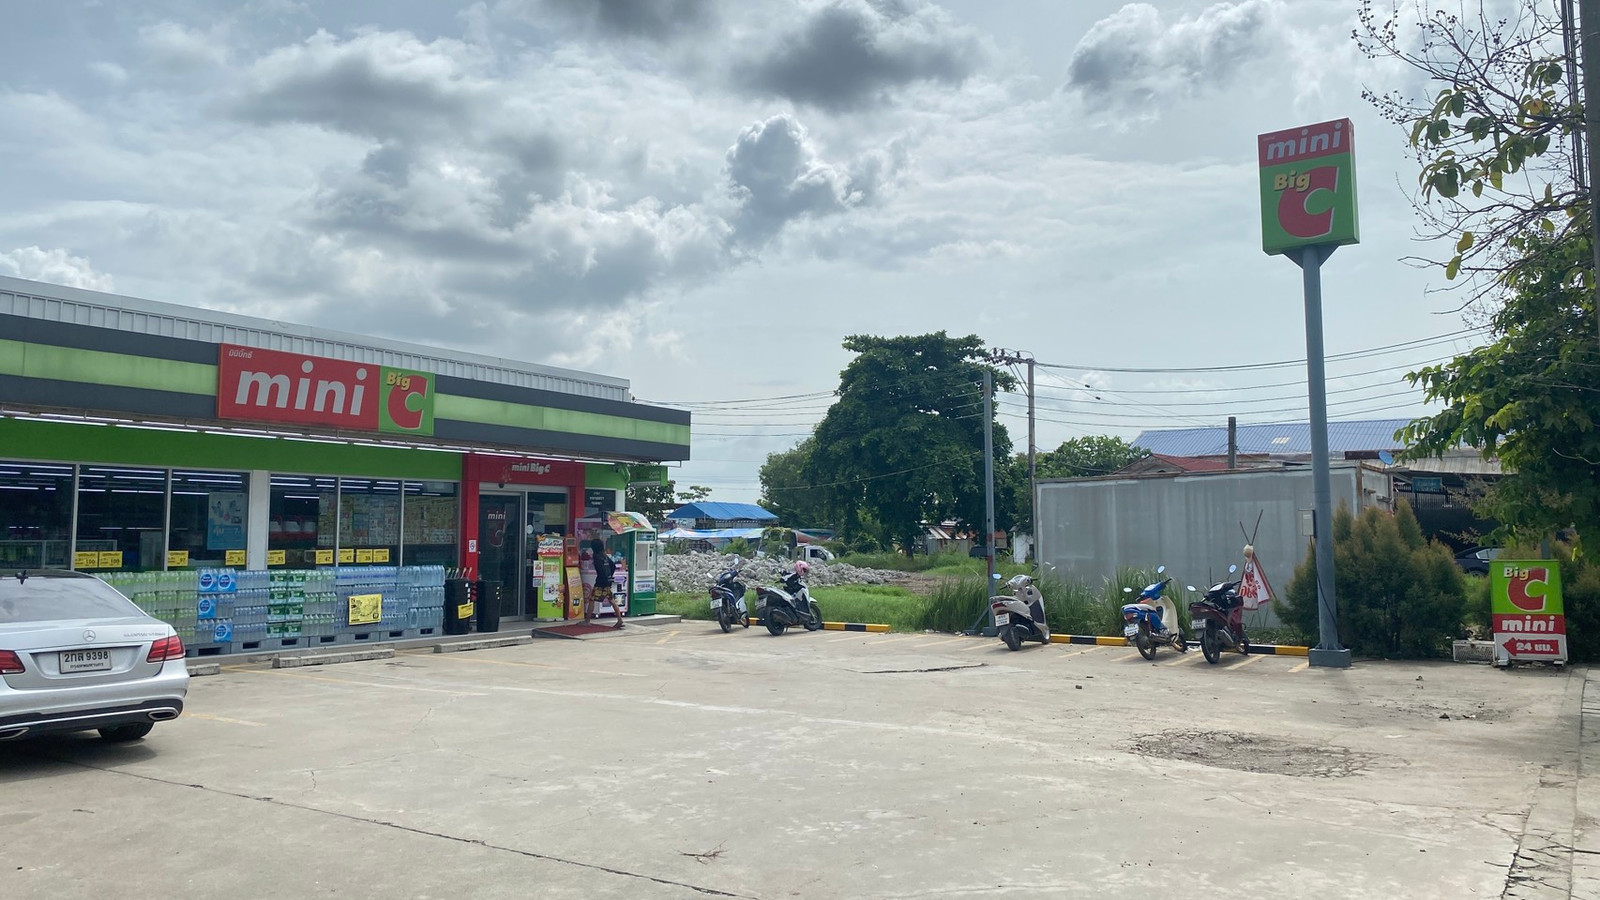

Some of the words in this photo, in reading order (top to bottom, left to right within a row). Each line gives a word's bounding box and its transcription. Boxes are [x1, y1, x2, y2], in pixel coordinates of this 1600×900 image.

[1266, 122, 1342, 160] mini
[1274, 169, 1311, 192] Big
[1278, 166, 1339, 239] C
[235, 360, 367, 416] mini
[387, 371, 411, 391] Big
[387, 375, 428, 429] C
[511, 462, 530, 472] mini
[487, 510, 506, 520] mini
[1504, 567, 1530, 580] Big
[1507, 567, 1549, 612] C
[1502, 615, 1555, 632] mini
[86, 651, 109, 660] 9398
[1516, 642, 1532, 651] 24
